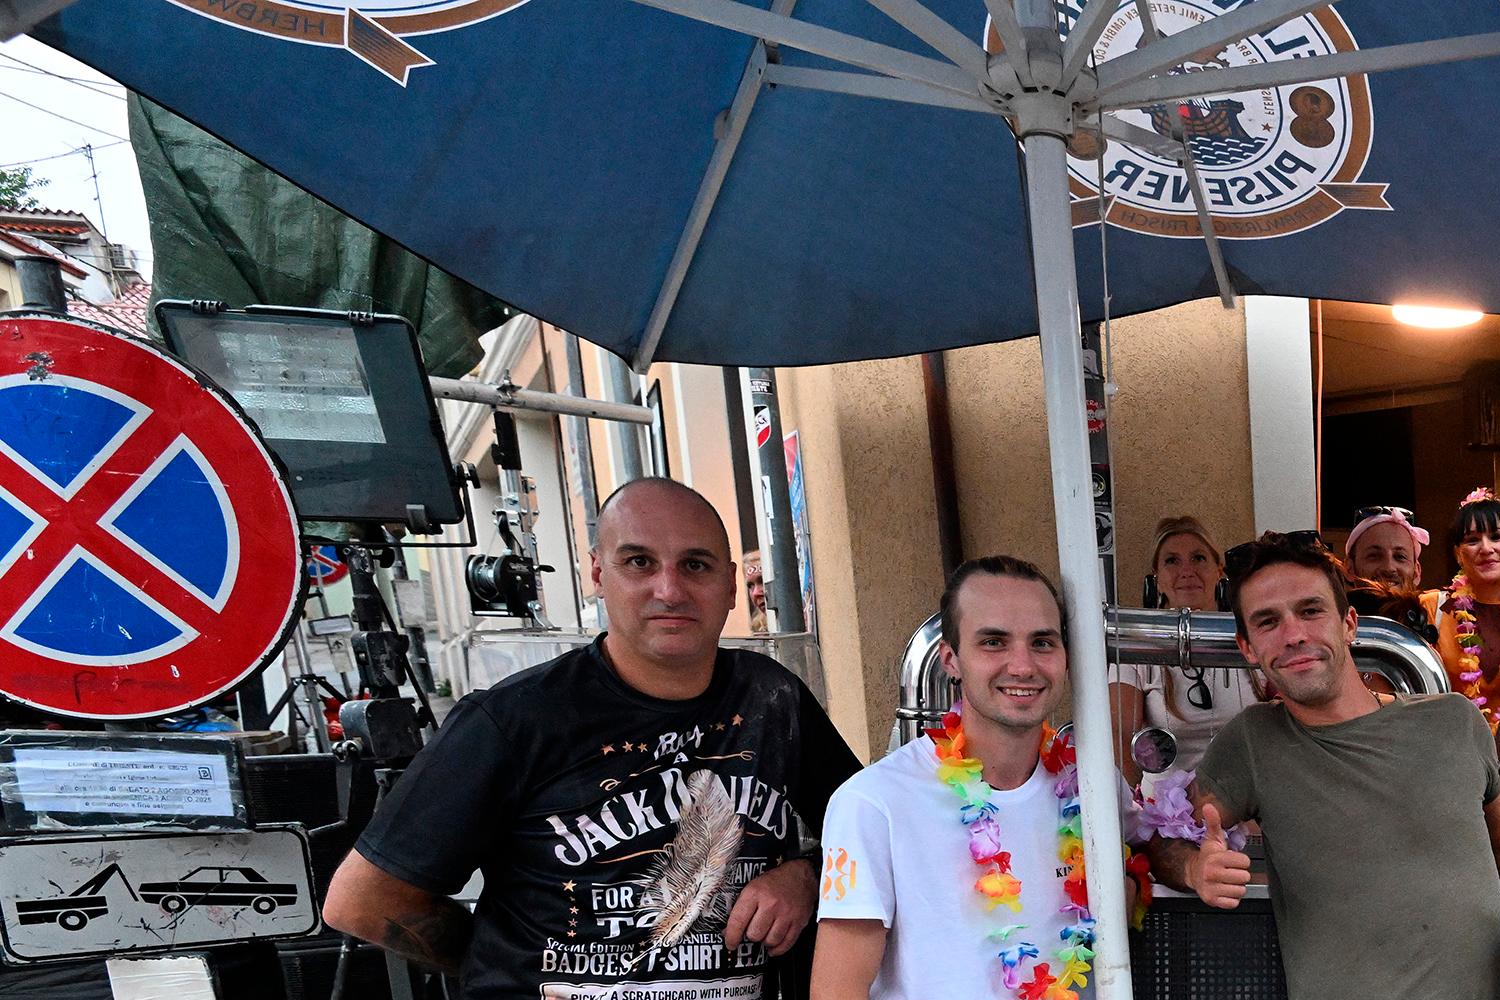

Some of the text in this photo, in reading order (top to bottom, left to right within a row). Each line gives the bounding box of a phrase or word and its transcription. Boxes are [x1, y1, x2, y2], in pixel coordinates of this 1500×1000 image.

[654, 725, 704, 760] Buy
[673, 752, 689, 764] A
[546, 767, 794, 866] JACK DNIEL'S
[592, 887, 634, 911] FOR
[590, 941, 635, 954] EDITION
[647, 944, 724, 972] T-SHIRT
[541, 949, 634, 976] BADGES
[610, 991, 619, 1000] A
[622, 989, 698, 1000] SCRATCHCARD
[699, 988, 722, 1000] WITH
